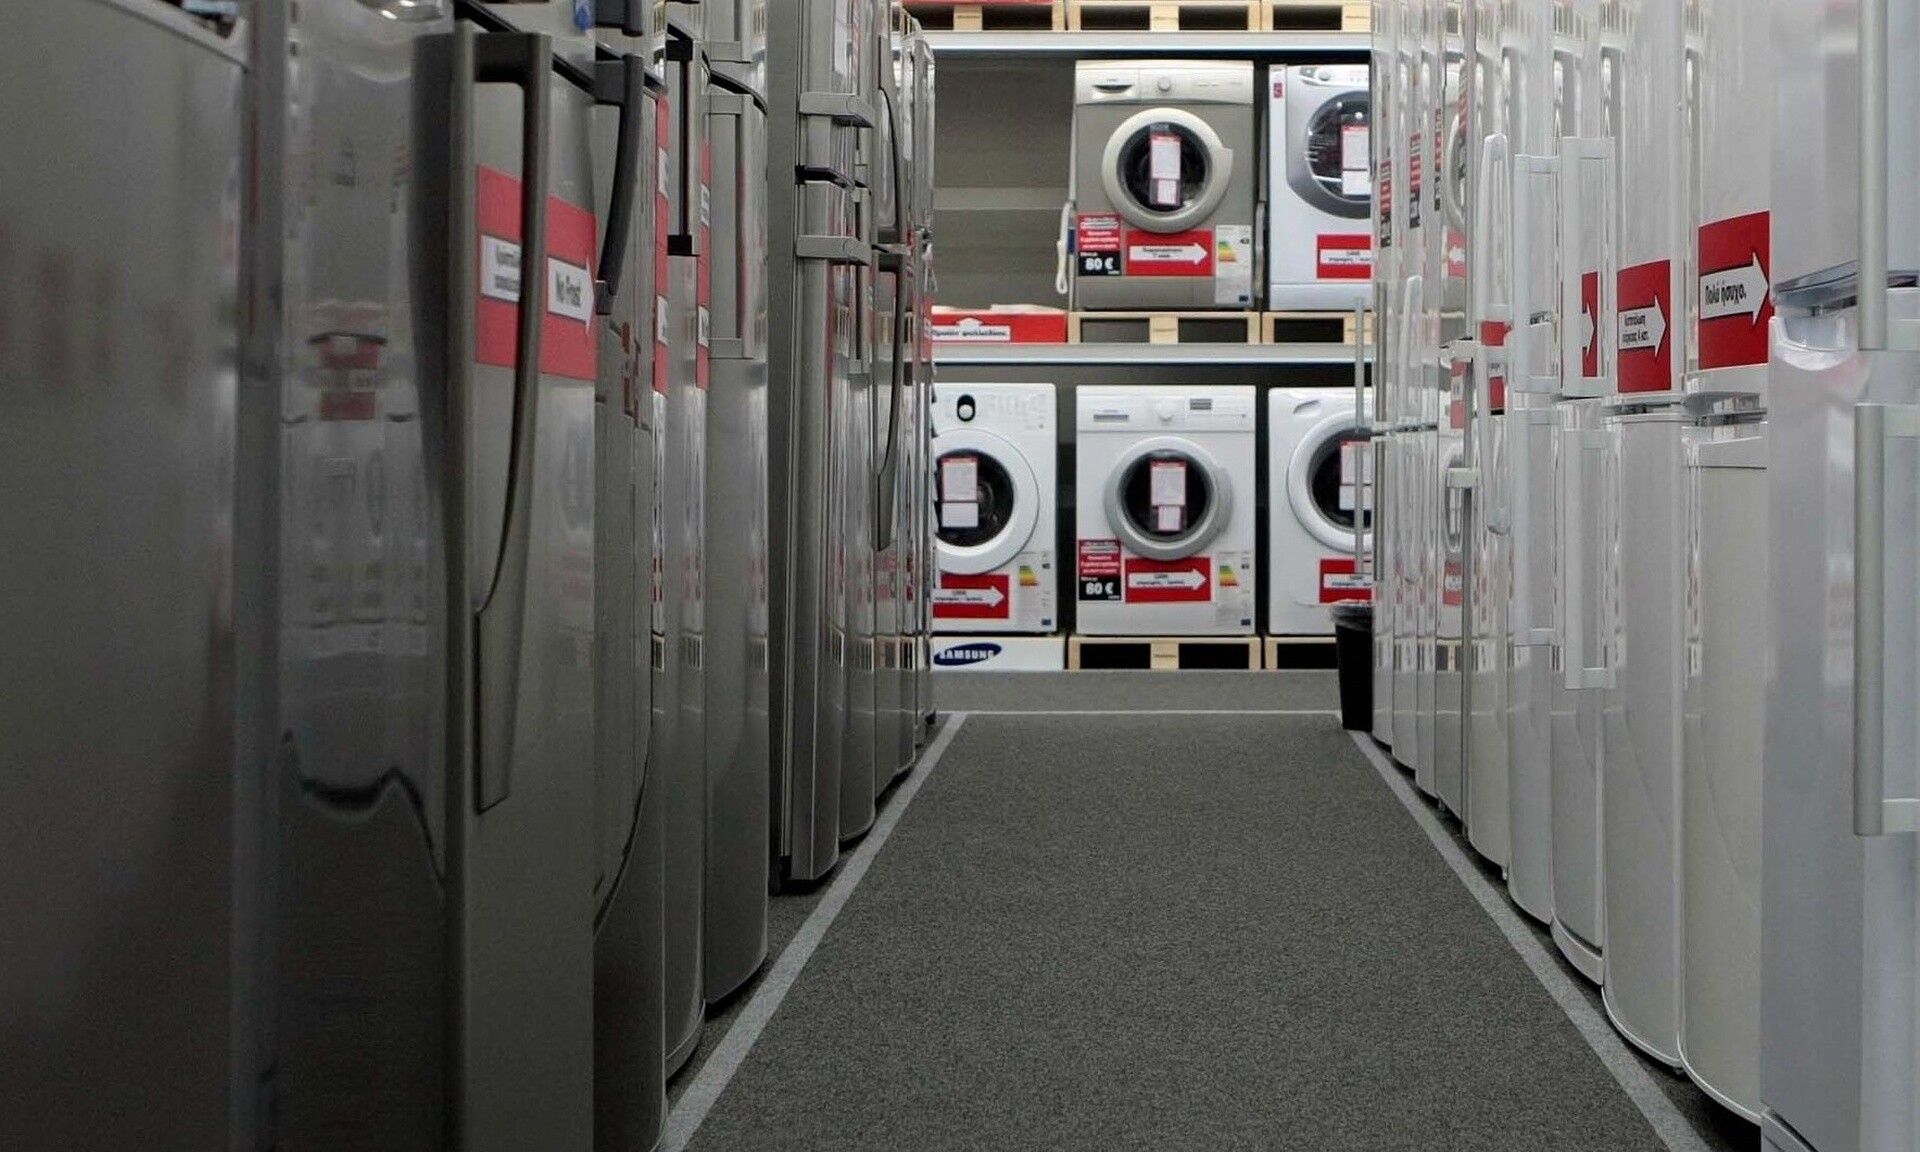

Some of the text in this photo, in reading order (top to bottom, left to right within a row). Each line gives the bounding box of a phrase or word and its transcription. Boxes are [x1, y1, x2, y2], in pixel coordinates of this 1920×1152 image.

[1085, 257, 1114, 270] 80 €
[1105, 582, 1114, 595] €
